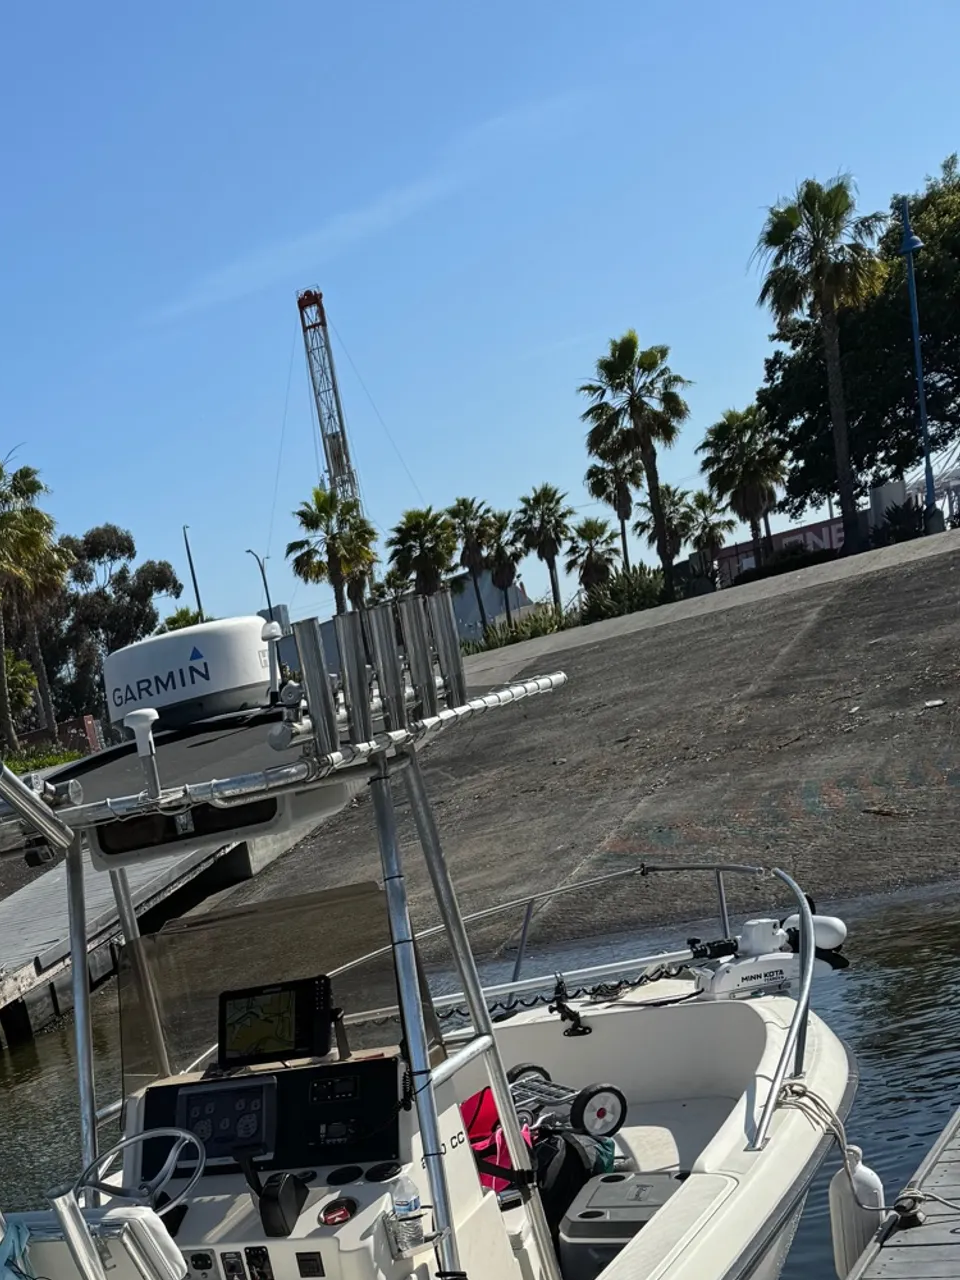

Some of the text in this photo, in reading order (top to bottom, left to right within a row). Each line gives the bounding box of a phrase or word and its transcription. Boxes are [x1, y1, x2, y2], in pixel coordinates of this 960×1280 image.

[112, 661, 210, 707] GARMIN
[741, 973, 762, 983] MINN
[764, 969, 784, 978] KOTA
[450, 1131, 465, 1149] CC
